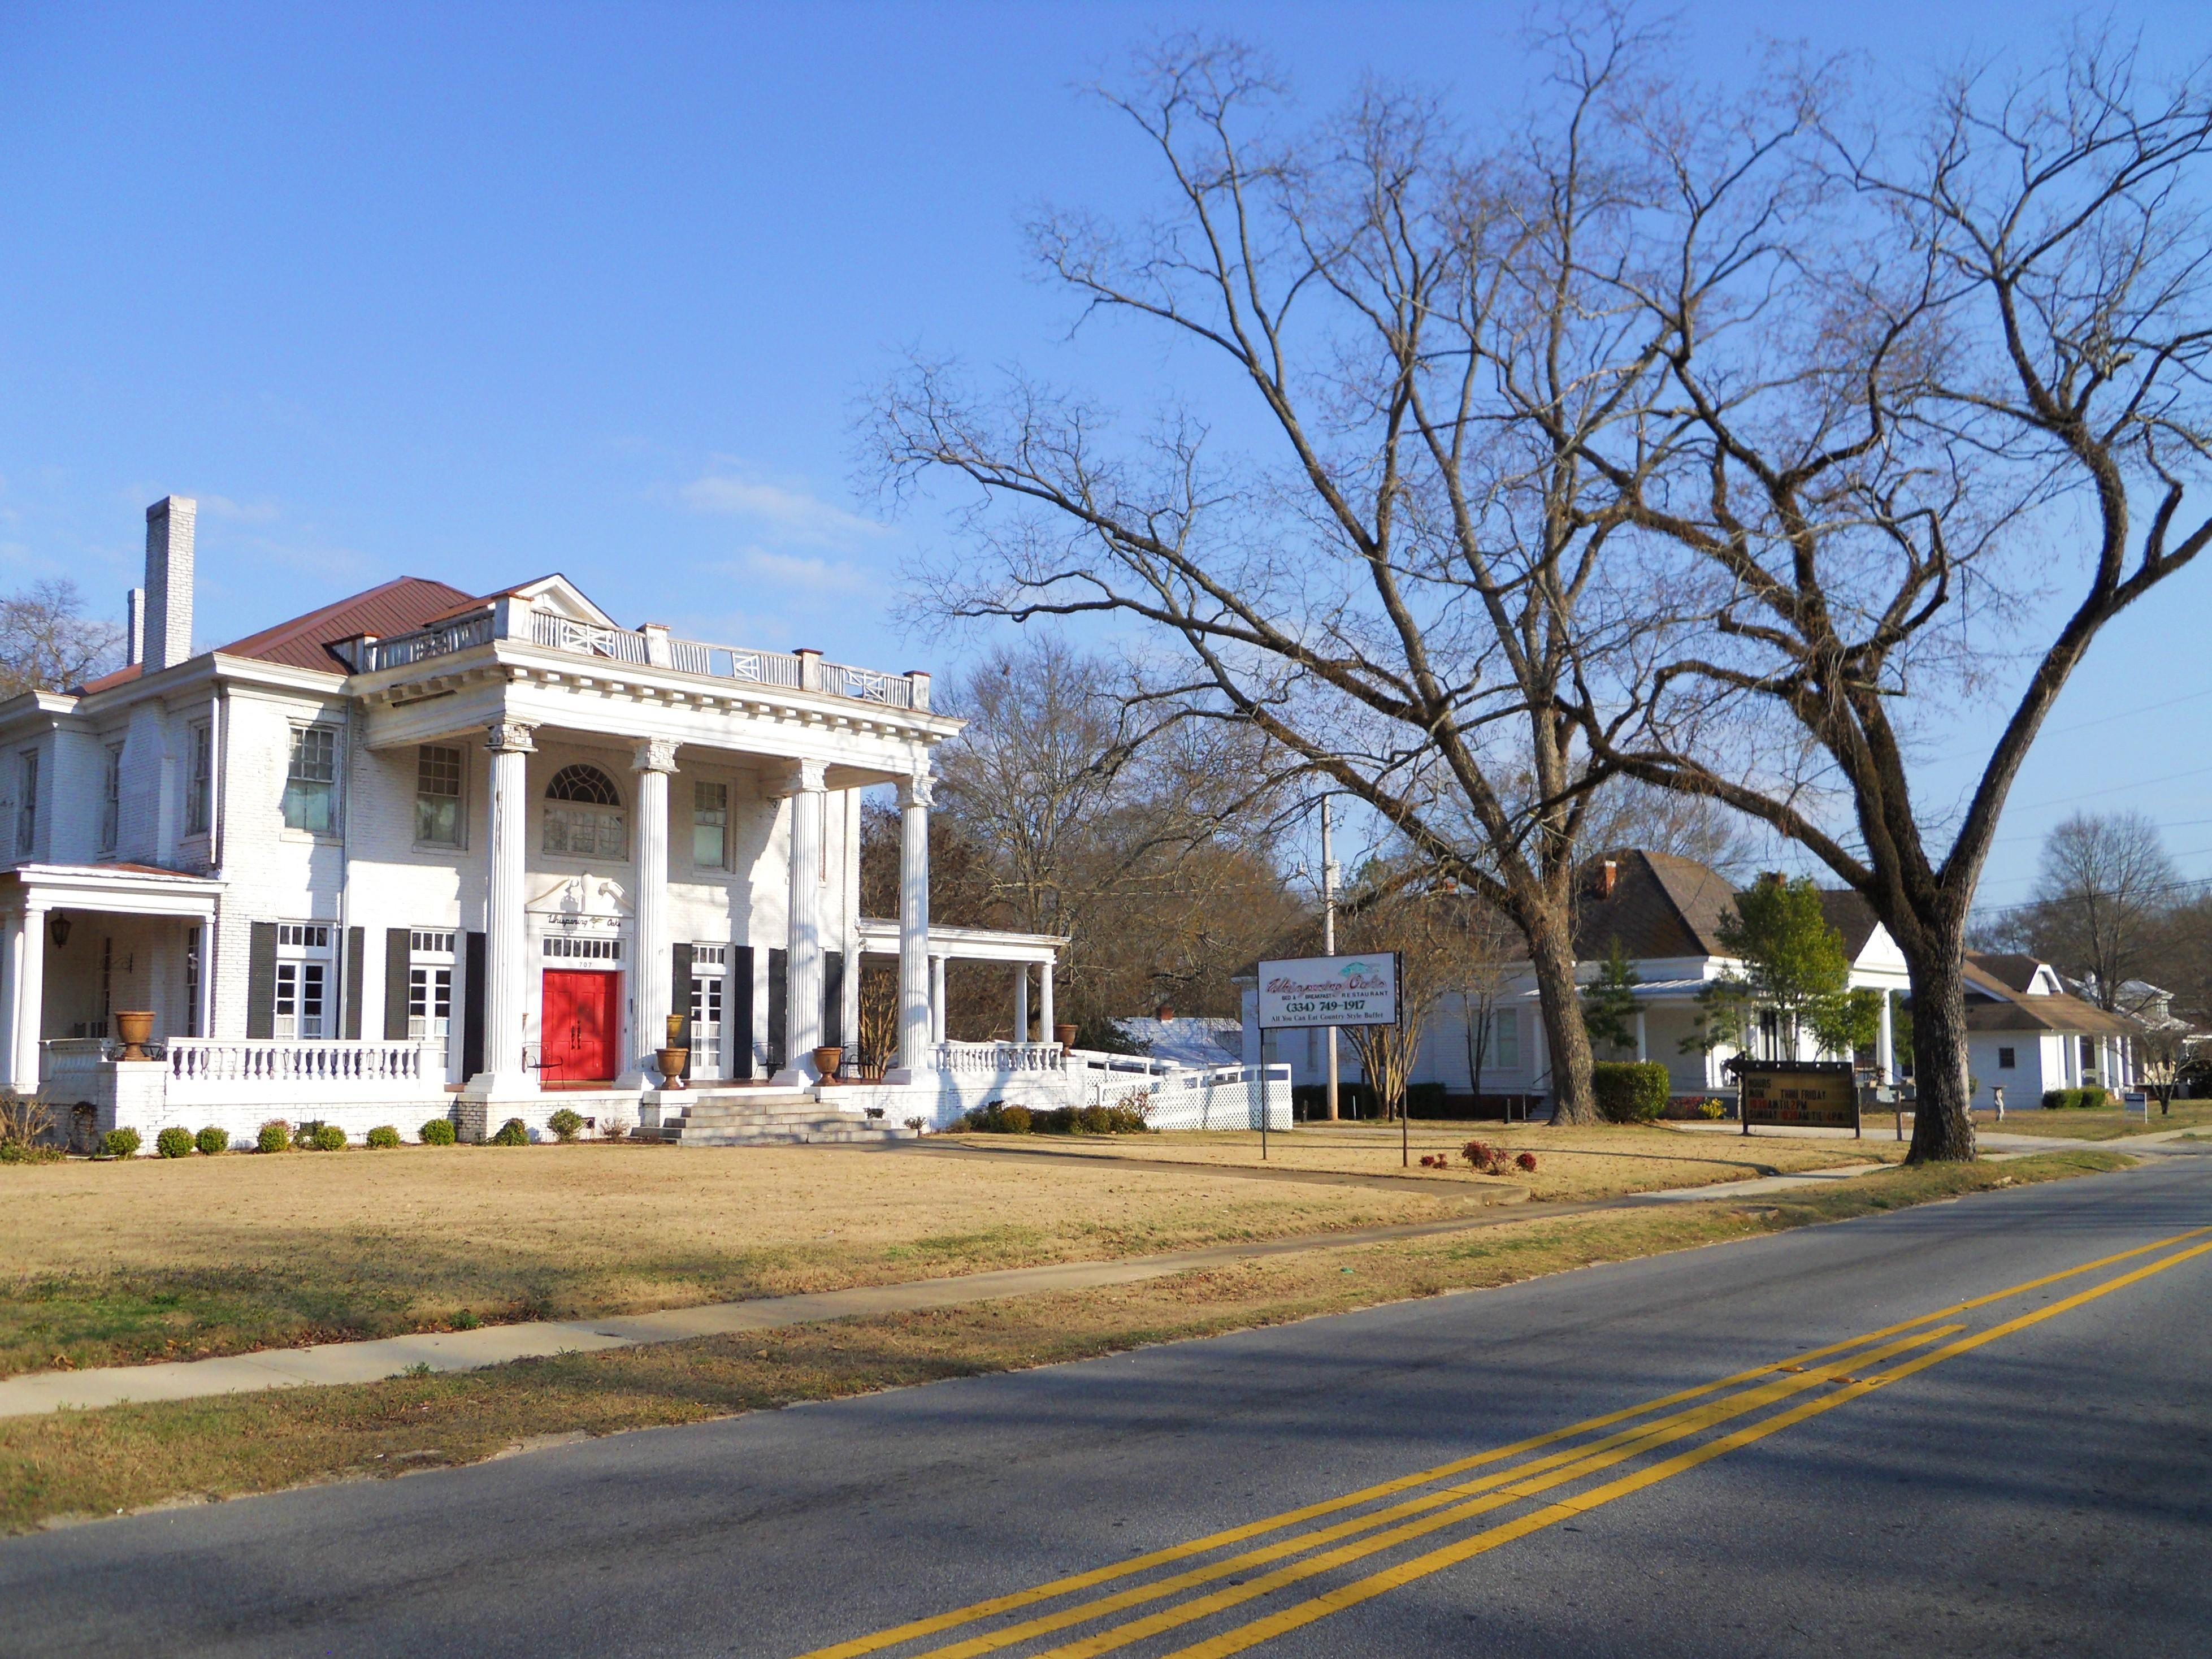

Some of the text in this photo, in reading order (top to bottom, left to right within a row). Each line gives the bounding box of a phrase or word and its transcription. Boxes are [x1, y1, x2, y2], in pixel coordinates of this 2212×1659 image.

[1286, 1000, 1365, 1013] (334) 749-1917
[1801, 1090, 1826, 1100] FRIDAY
